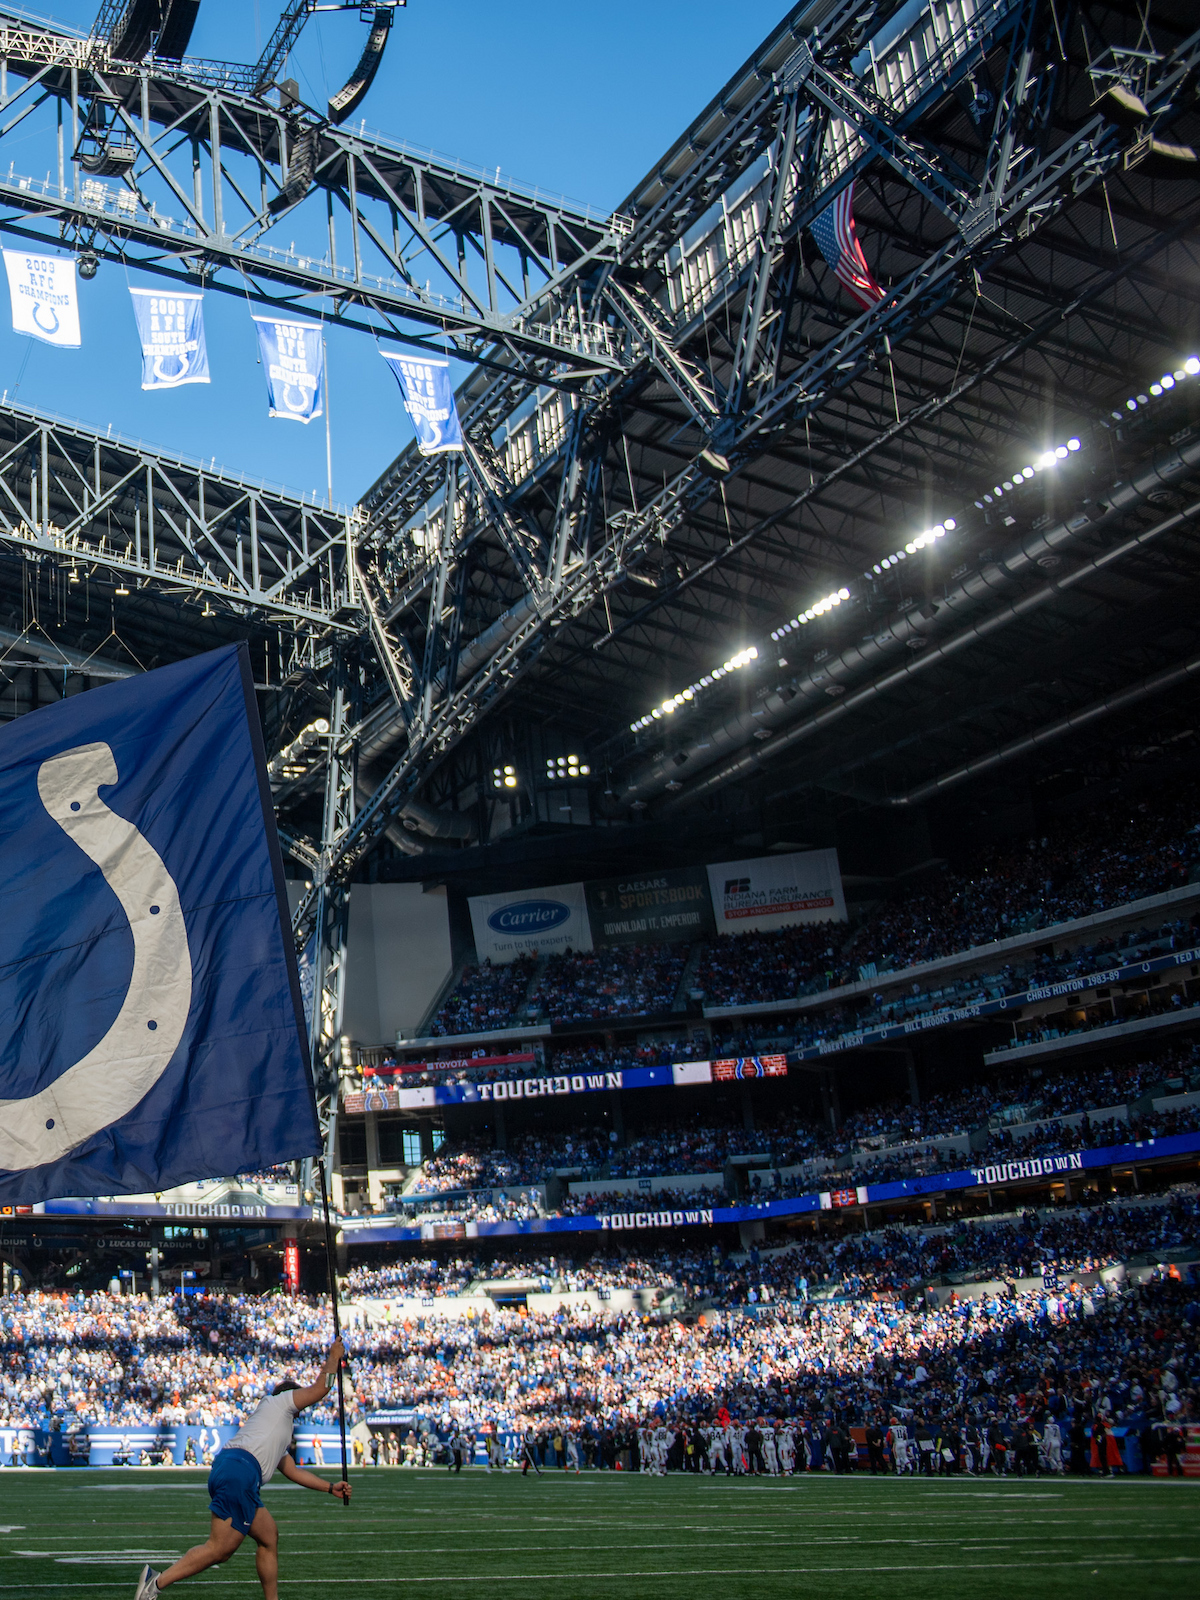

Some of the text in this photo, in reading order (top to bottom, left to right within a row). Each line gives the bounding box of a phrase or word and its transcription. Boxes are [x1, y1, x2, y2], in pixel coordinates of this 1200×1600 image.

[25, 258, 55, 274] 2009
[18, 284, 70, 306] CHAMPIONS
[150, 298, 185, 316] 2009
[151, 331, 186, 344] SOUTH
[274, 323, 304, 341] 2007
[143, 339, 198, 356] CHAMPIONS
[400, 361, 433, 381] 2006
[617, 878, 669, 894] CAESARS
[723, 886, 798, 902] INDIANA FARM
[619, 884, 705, 910] SPORTSBOOK
[723, 889, 833, 910] BUREAU INSURANCE
[499, 907, 559, 928] Carrier
[727, 899, 832, 919] STOP KNOCKING ON WOOD
[603, 919, 648, 936] DOWNLOAD
[660, 912, 700, 928] EMPEROR!
[492, 935, 574, 952] Turn to the experts
[1173, 952, 1193, 965] TED
[1026, 970, 1121, 1003] CHRIS HINTON 1983-89
[903, 1007, 981, 1034] BILL BROOKS 1986-92
[819, 1041, 845, 1055] ROBERT
[433, 1058, 469, 1071] TOYOTA
[476, 1071, 624, 1102] TOUCHDOWN
[973, 1153, 1083, 1185] TOUCHDOWN
[164, 1202, 268, 1218] TOUCHDOWN
[601, 1208, 715, 1231] TOUCHDOWN
[109, 1240, 136, 1249] LUCAS
[157, 1241, 193, 1249] TADIUM
[288, 1240, 297, 1280] LUCAS
